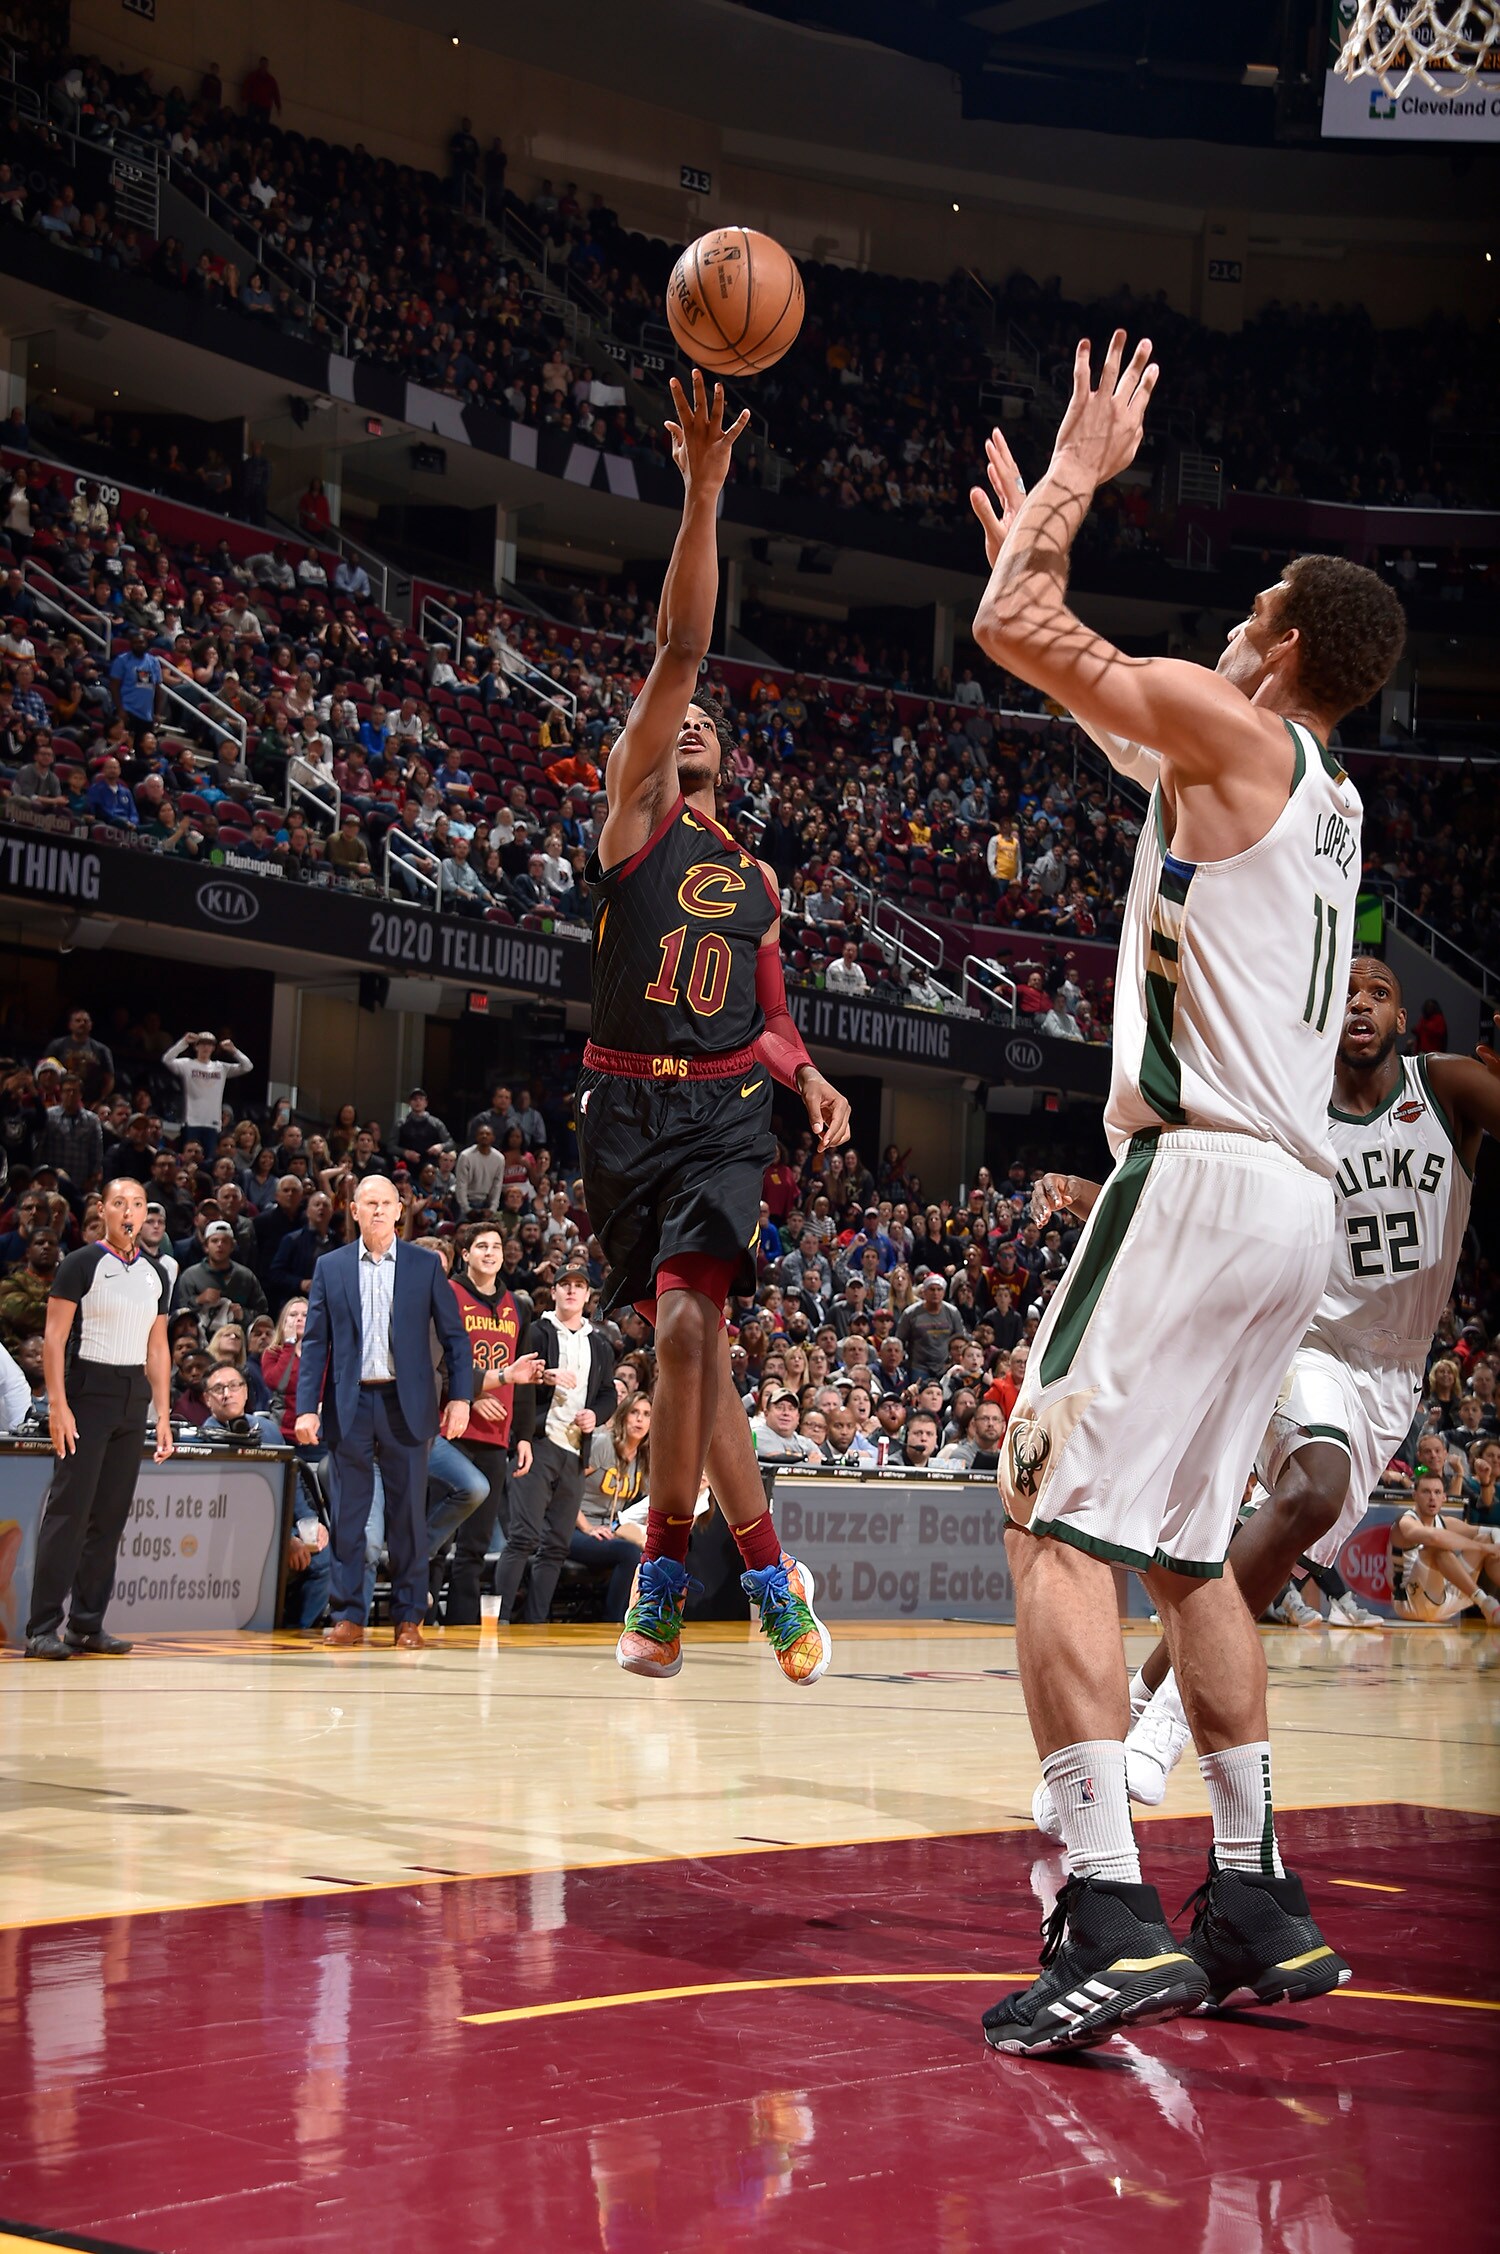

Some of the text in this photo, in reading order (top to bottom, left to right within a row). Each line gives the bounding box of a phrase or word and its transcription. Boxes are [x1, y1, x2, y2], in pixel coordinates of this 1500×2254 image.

[1402, 97, 1486, 116] Cleveland
[682, 169, 710, 191] 213
[643, 354, 665, 371] 213
[75, 477, 120, 506] C09
[1314, 812, 1357, 880] LOPEZ
[226, 852, 284, 877] Huntington
[207, 888, 248, 916] KIA
[369, 911, 564, 987] 2020 TELLURIDE
[645, 924, 733, 1018] 10
[1300, 892, 1339, 1040] 11
[814, 1000, 834, 1038] IT
[838, 1006, 950, 1059] EVERYTHING
[652, 1058, 688, 1077] CAVS
[1011, 1044, 1038, 1066] KIA
[1334, 1148, 1446, 1200] UCKS
[1346, 1209, 1421, 1279] 22
[465, 1315, 516, 1338] CLEVELAND
[473, 1339, 509, 1370] 32
[175, 1495, 203, 1518] ate
[208, 1494, 228, 1518] all
[781, 1502, 1005, 1546] Buzzer Beat
[132, 1532, 176, 1562] dogs.
[1347, 1544, 1392, 1591] Sug
[852, 1561, 920, 1613] Dog
